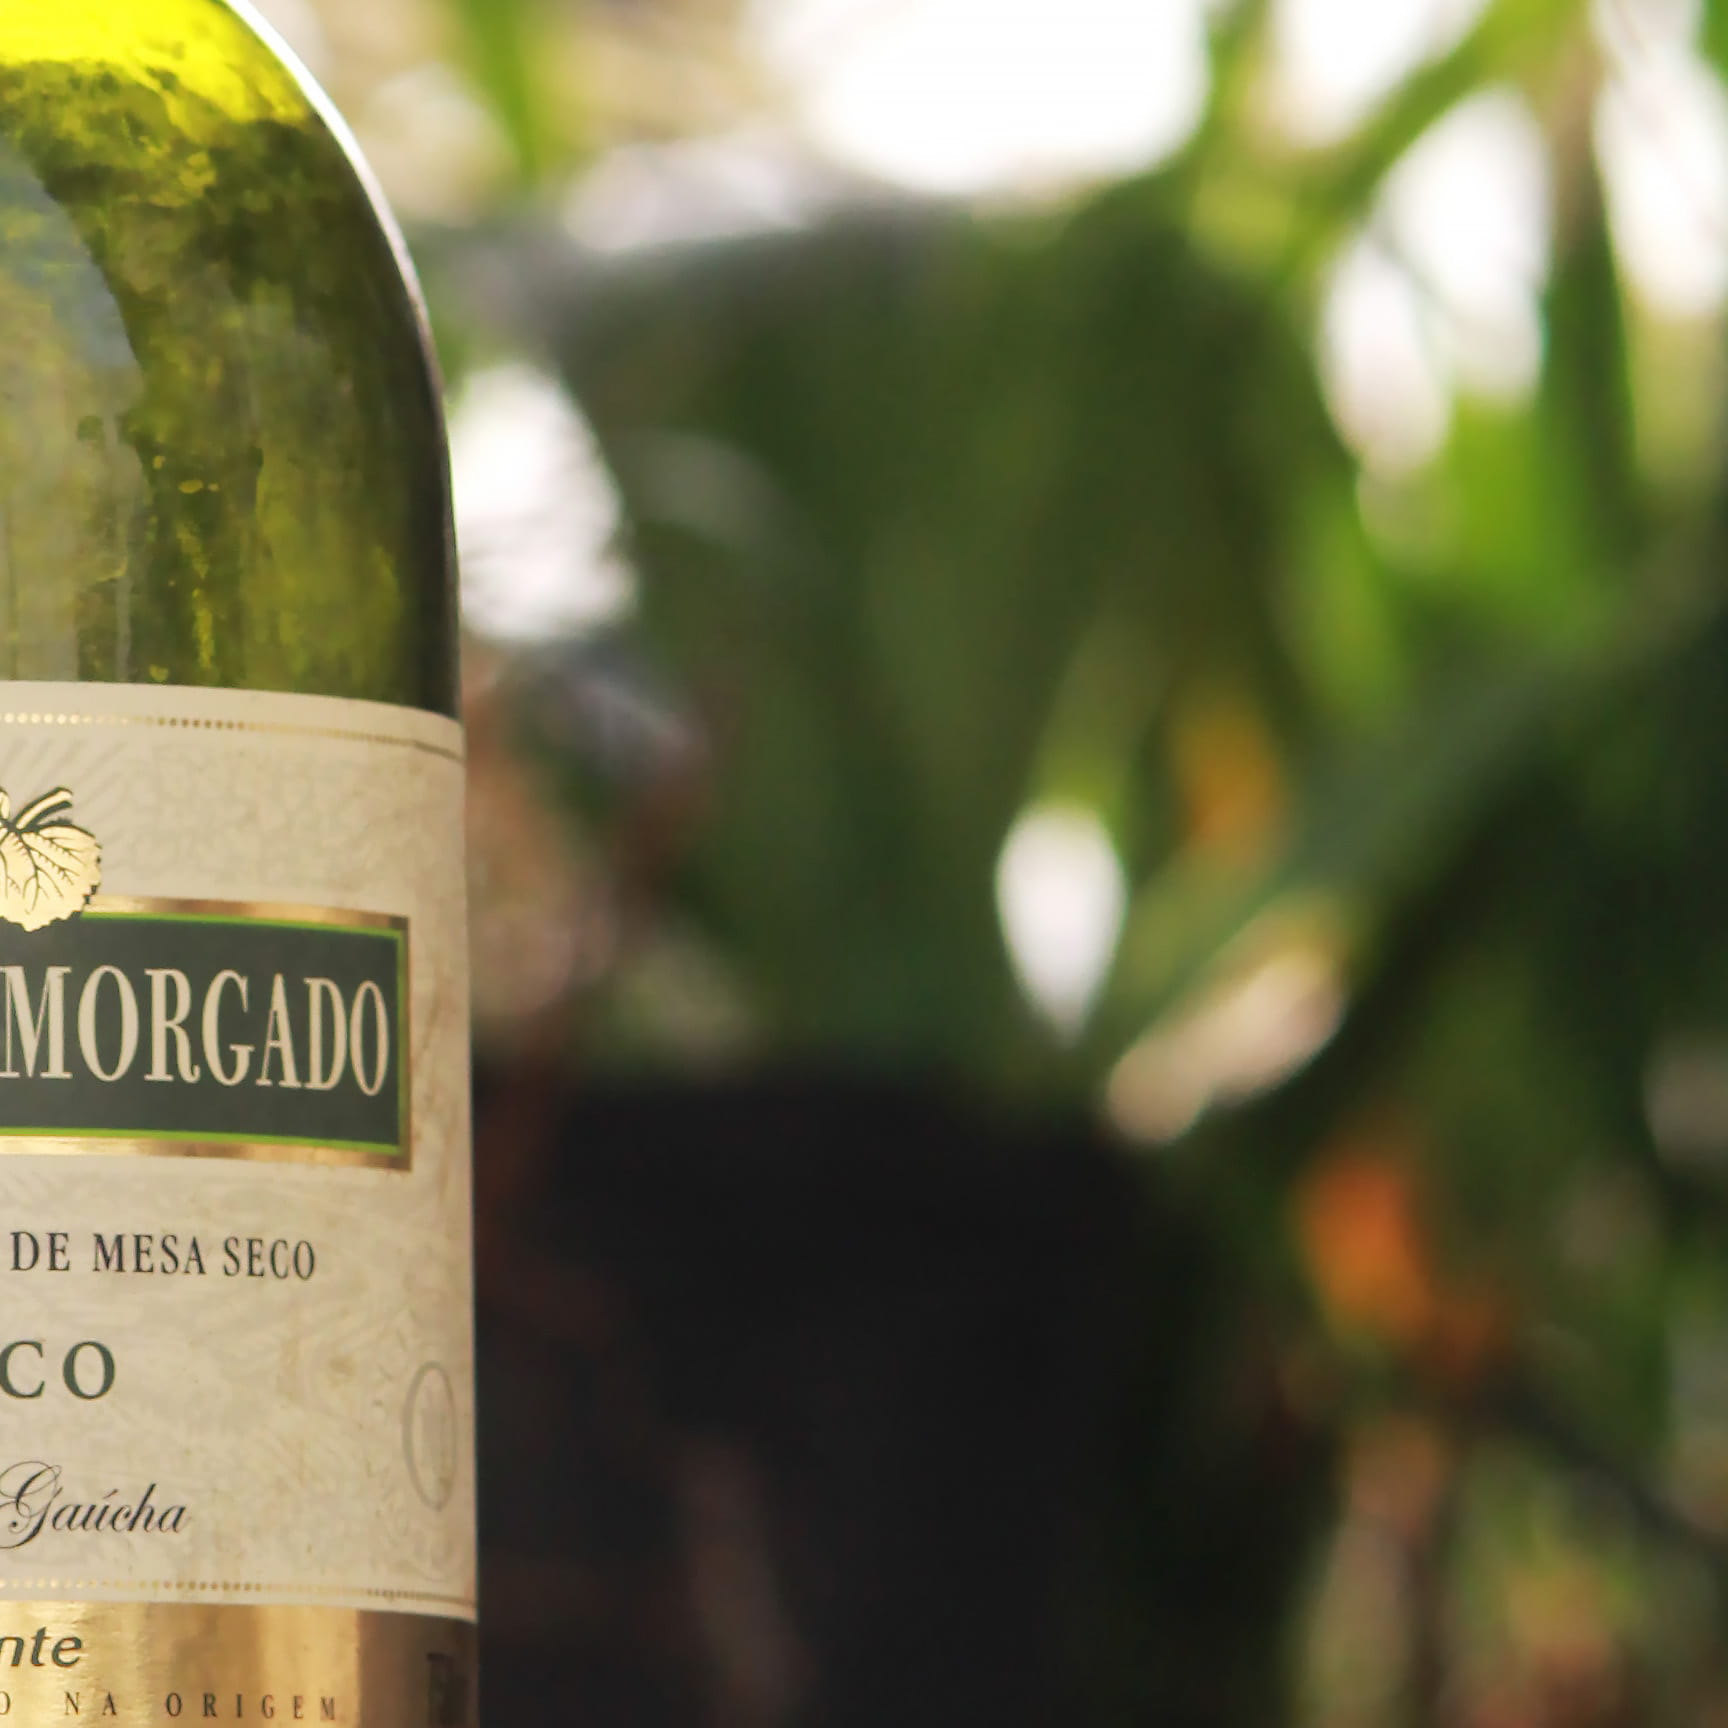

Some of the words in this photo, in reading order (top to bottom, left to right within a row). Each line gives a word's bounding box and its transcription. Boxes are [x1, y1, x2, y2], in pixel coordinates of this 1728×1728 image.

[9, 1231, 71, 1272] DE
[91, 1232, 207, 1275] MESA
[222, 1235, 317, 1281] SECO
[65, 1690, 118, 1718] NA
[165, 1691, 337, 1722] ORIGEM
